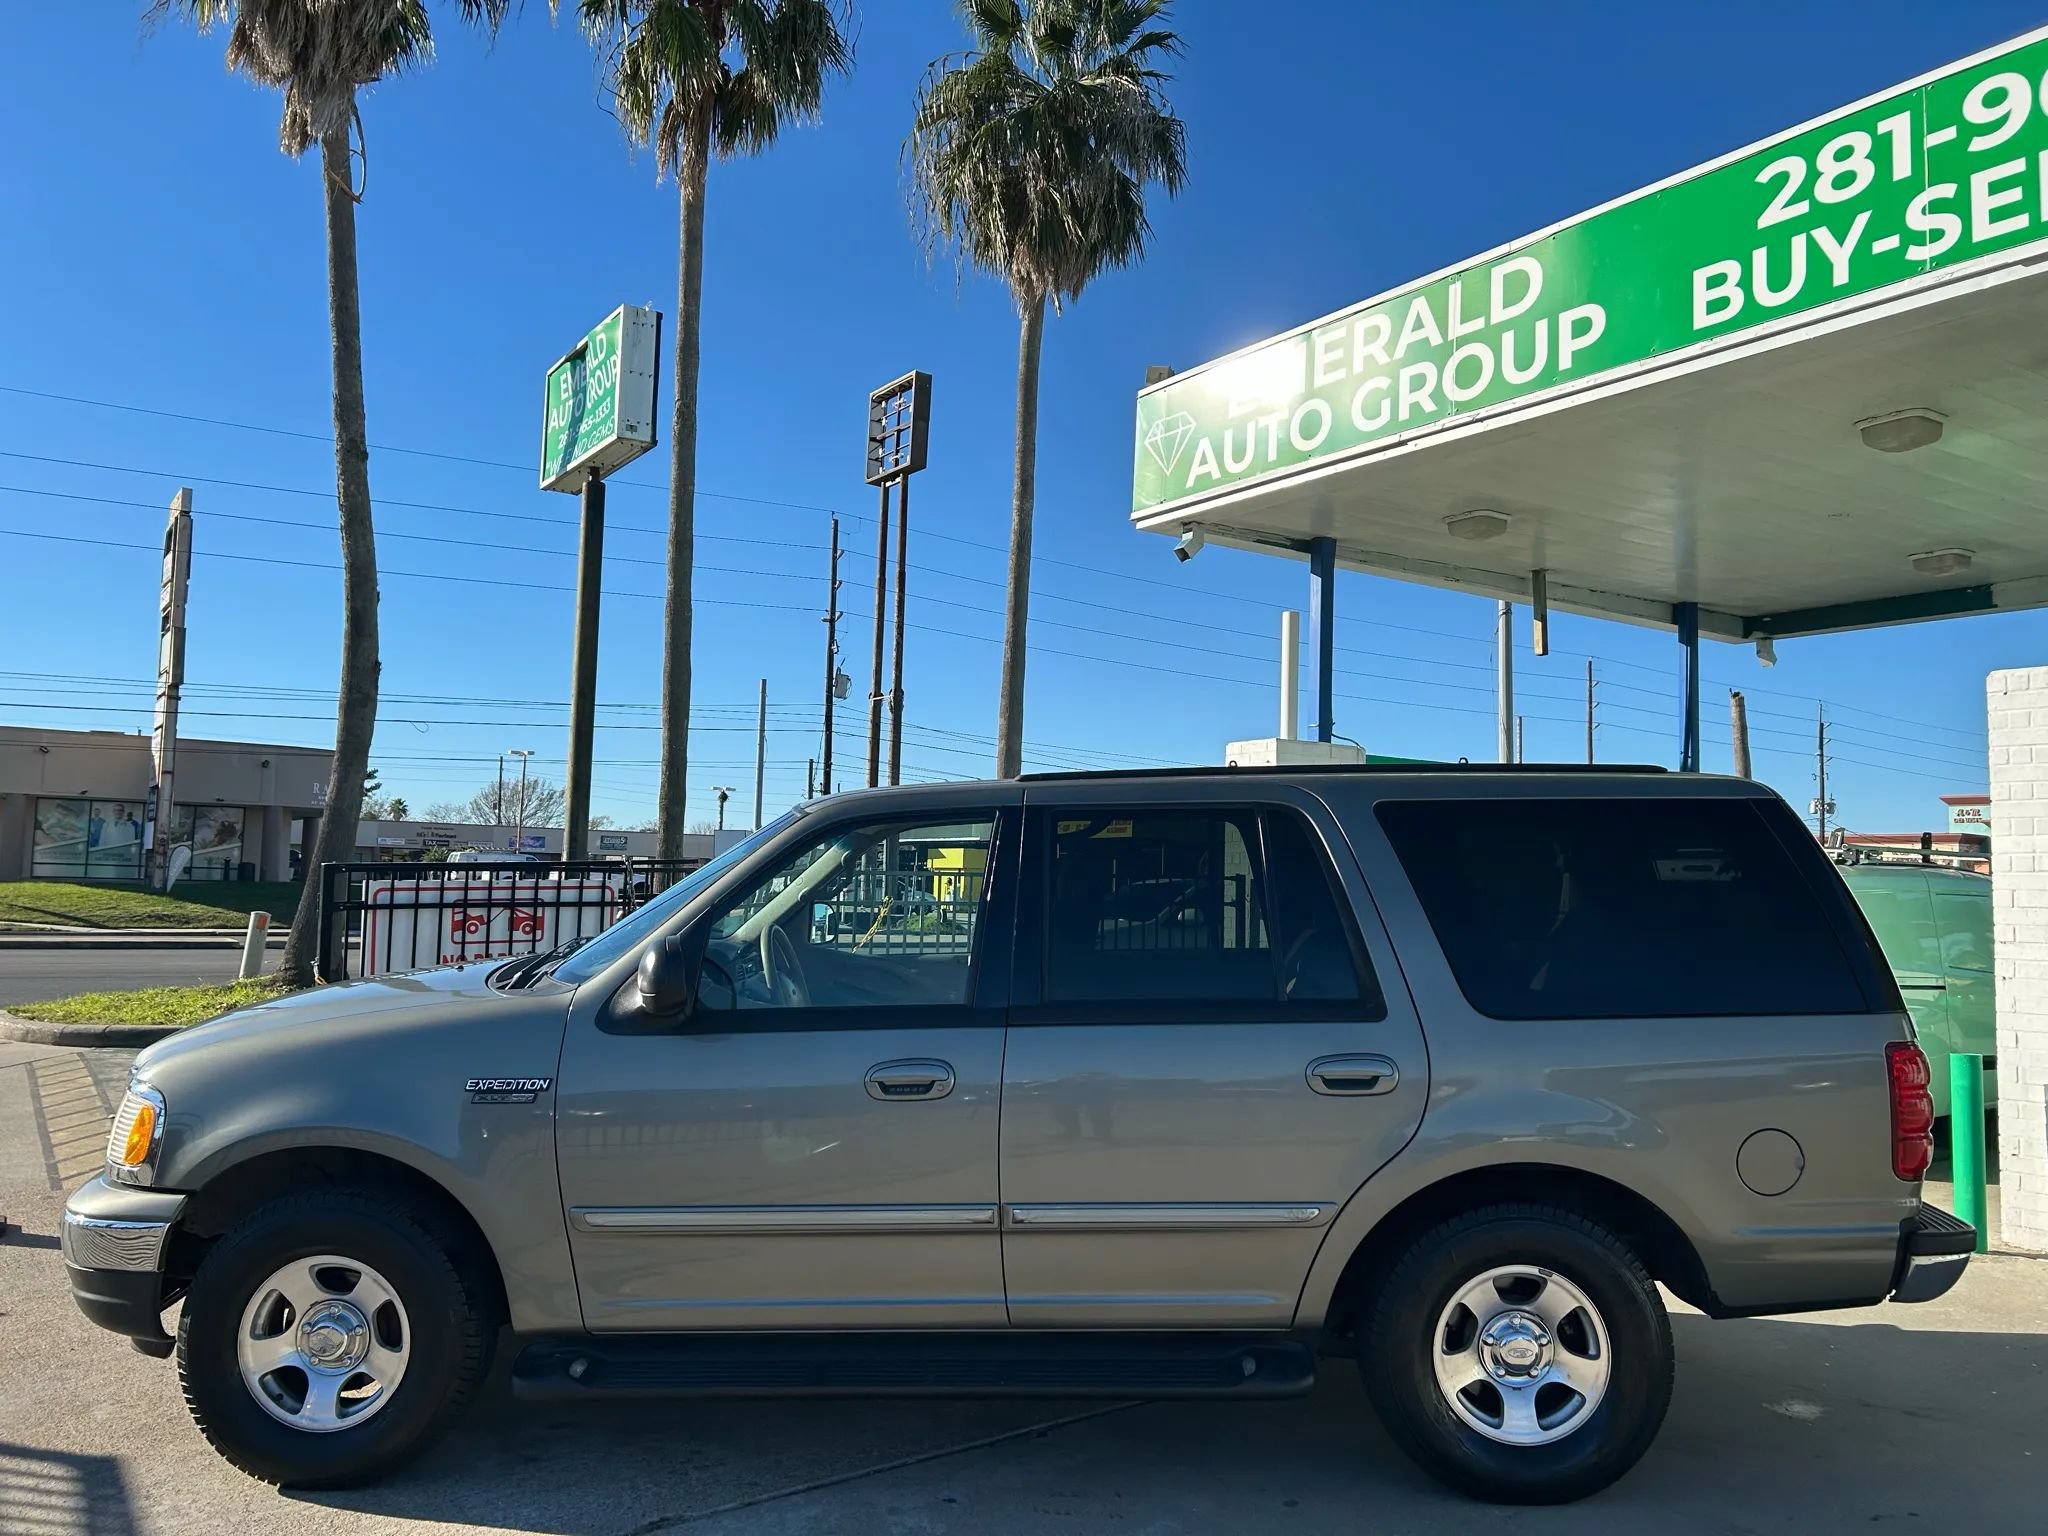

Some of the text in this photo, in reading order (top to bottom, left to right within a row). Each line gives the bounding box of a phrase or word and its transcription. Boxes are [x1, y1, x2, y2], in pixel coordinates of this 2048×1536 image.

[559, 332, 607, 401] EMEALD
[1227, 256, 1544, 420] ERALD
[546, 392, 584, 433] AUTO
[1185, 303, 1607, 489] AUTO GROUP
[465, 1079, 550, 1090] EXPEDITION
